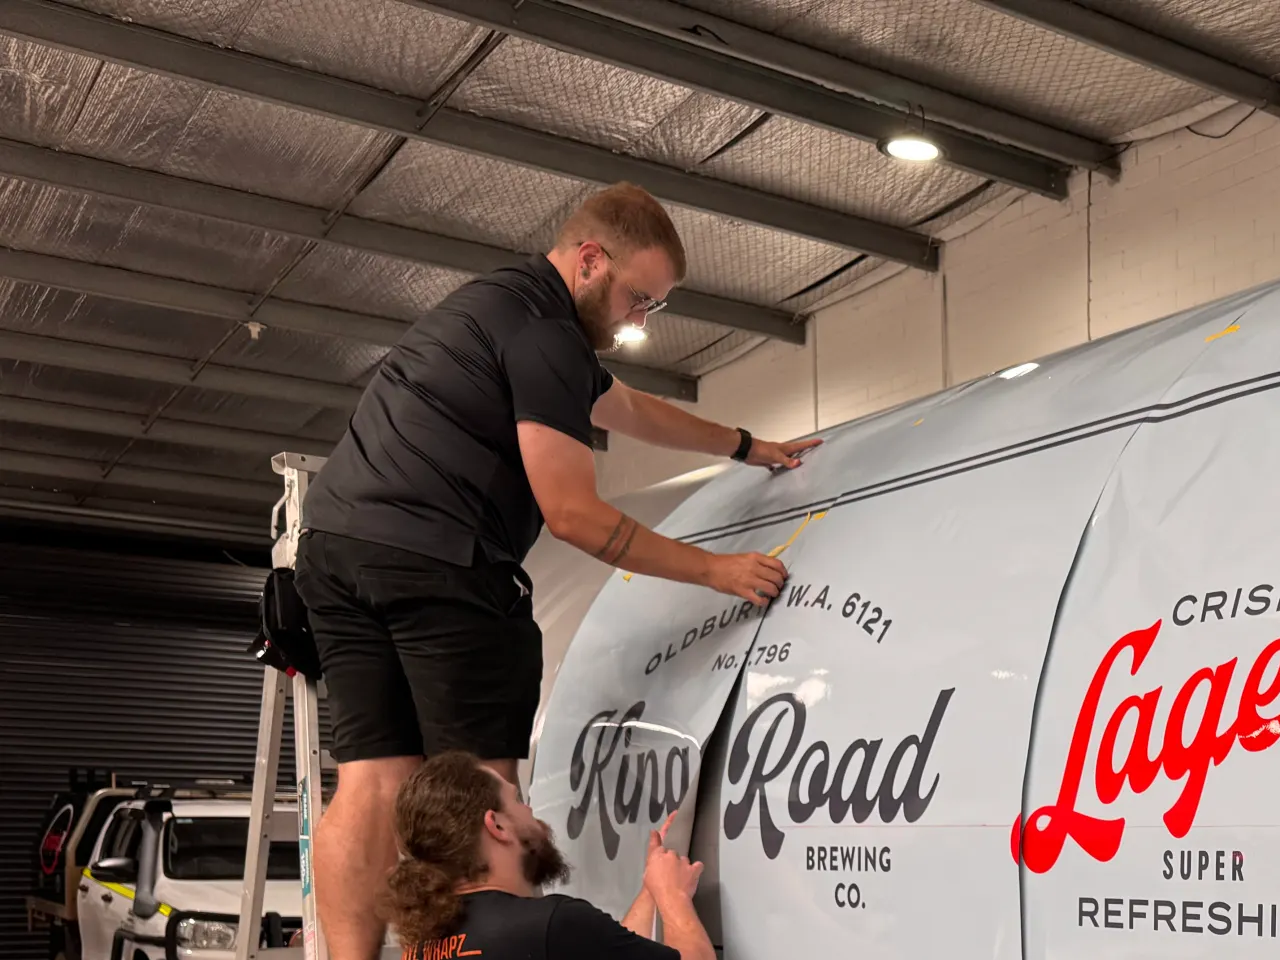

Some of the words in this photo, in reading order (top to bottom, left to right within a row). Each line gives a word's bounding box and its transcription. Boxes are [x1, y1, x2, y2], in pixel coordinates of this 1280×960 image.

[786, 584, 833, 611] W.A.
[842, 592, 892, 644] 6121
[723, 687, 956, 860] Road
[806, 846, 891, 873] BREWING
[1162, 850, 1244, 881] SUPER
[834, 883, 866, 909] CO.
